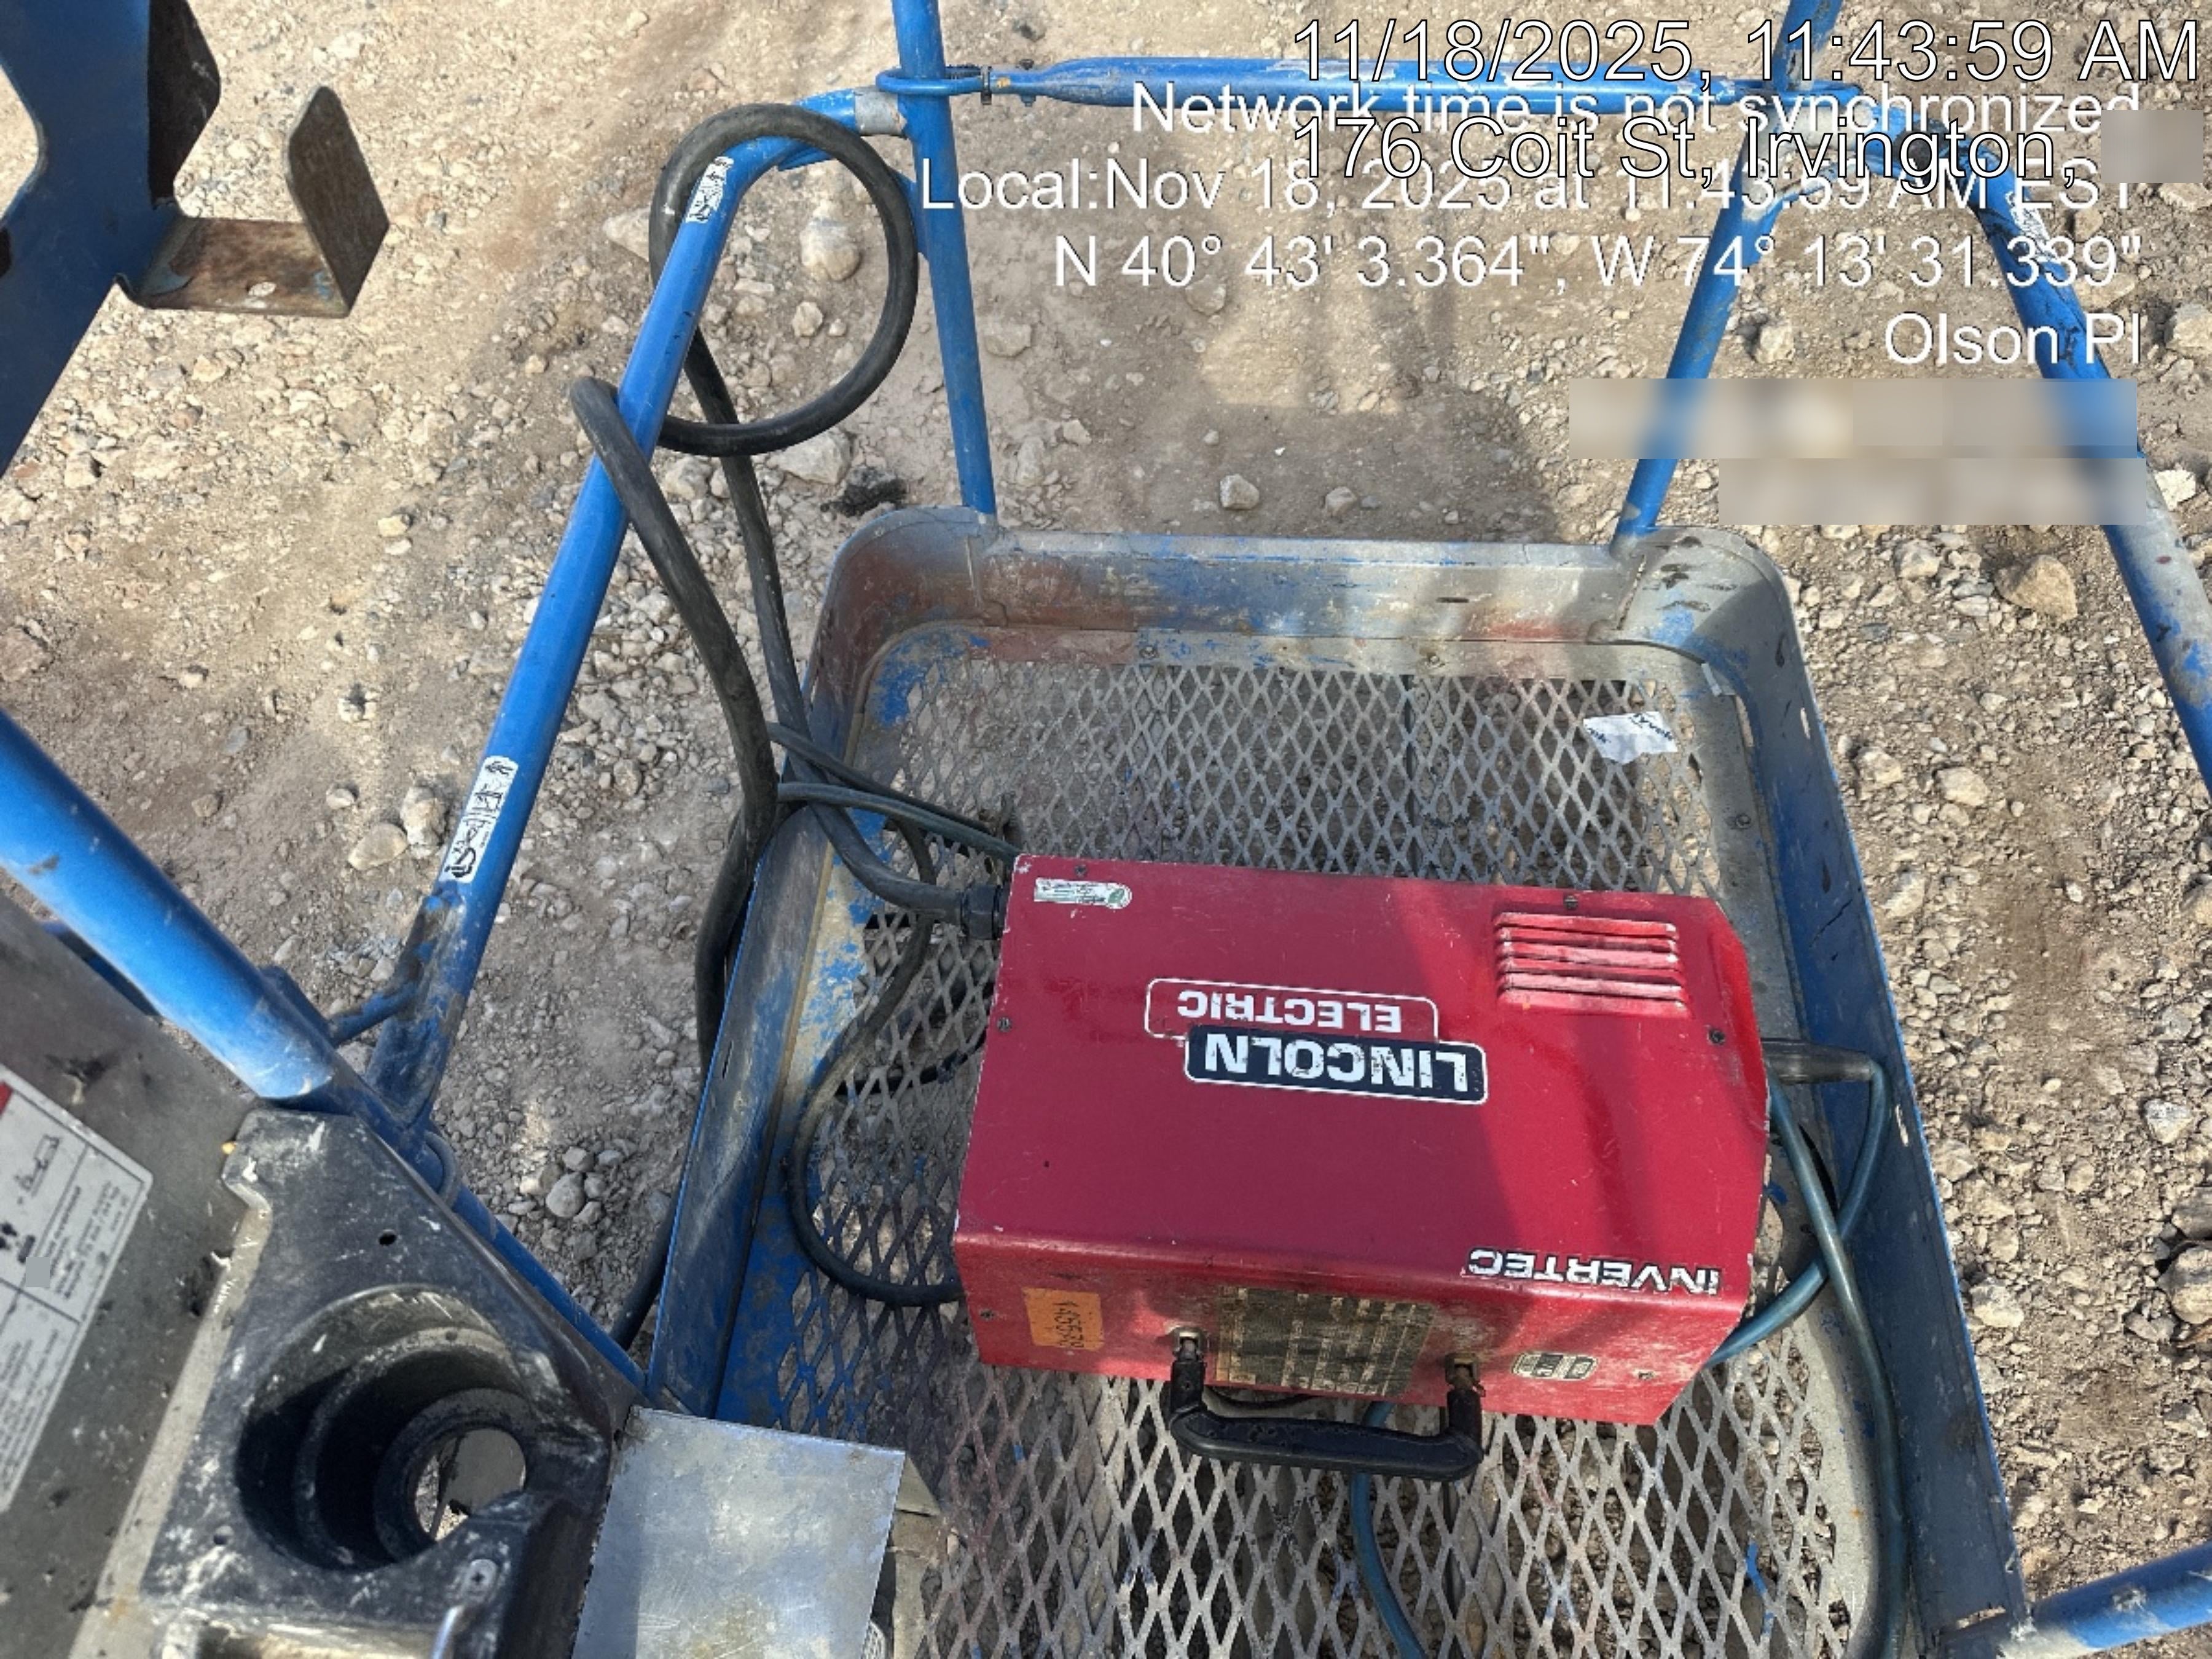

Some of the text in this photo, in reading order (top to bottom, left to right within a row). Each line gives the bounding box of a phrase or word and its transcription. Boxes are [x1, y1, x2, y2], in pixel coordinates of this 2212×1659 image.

[1177, 989, 1402, 1033] ELECTRIC
[1204, 1032, 1469, 1092] LINCOLN
[1469, 1248, 1720, 1296] INVERTEC
